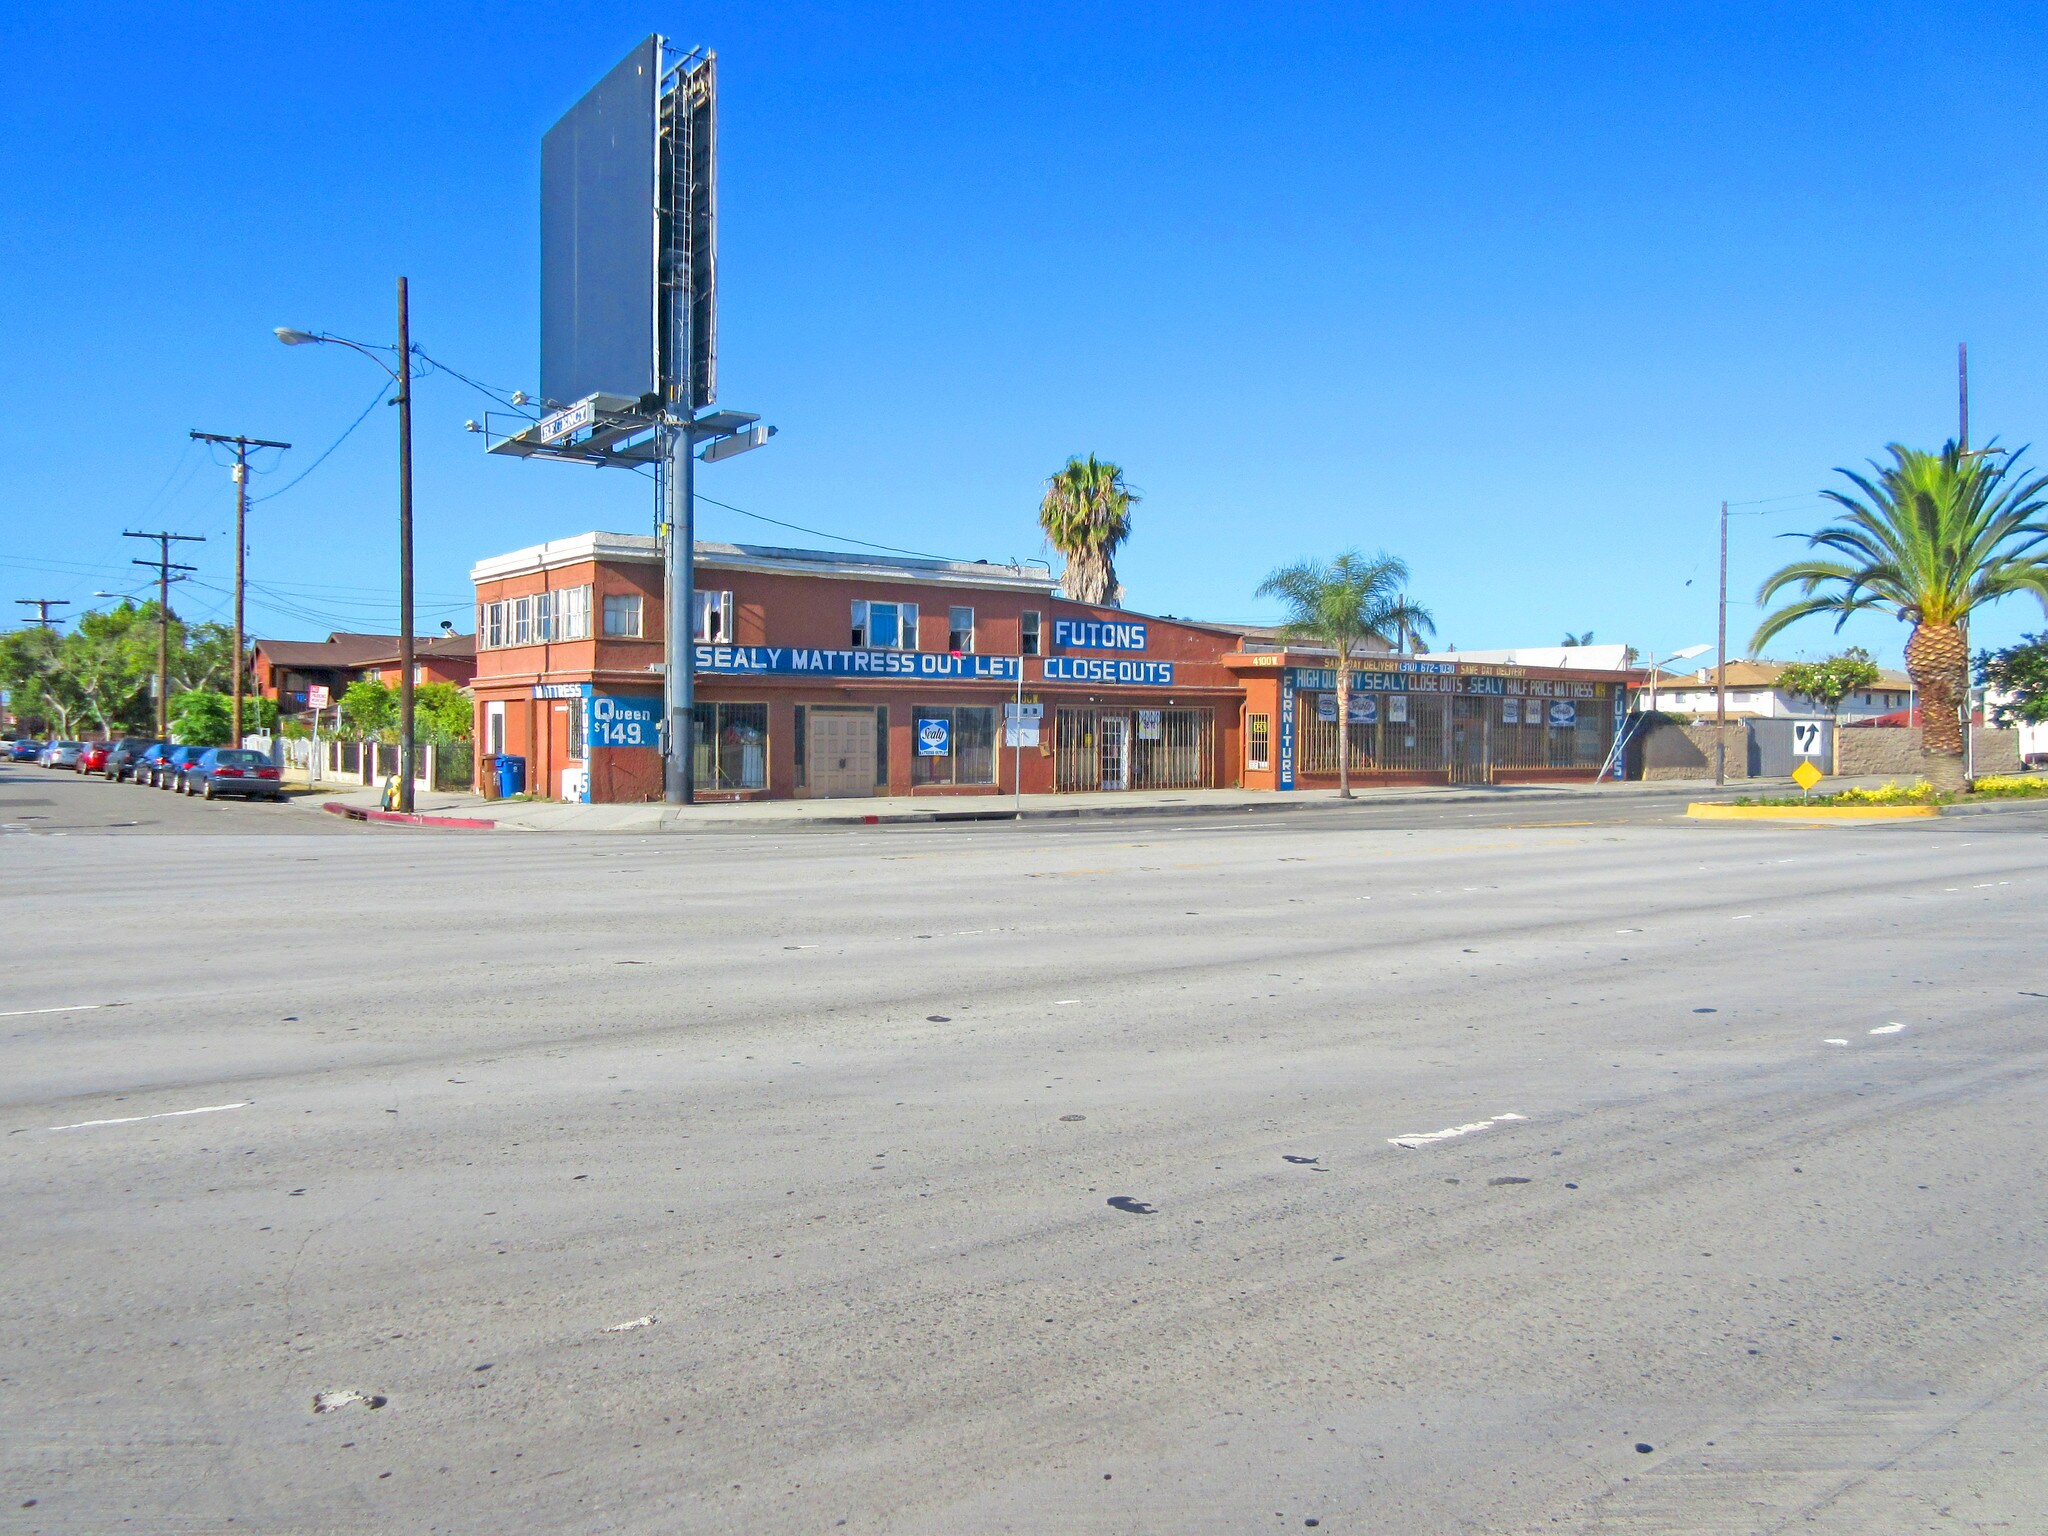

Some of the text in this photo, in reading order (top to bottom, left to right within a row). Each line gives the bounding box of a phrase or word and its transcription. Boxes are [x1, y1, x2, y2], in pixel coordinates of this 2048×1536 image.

[543, 407, 586, 439] REGENCY
[1056, 621, 1144, 649] FUTONS
[695, 646, 1018, 675] SEALY MATTRESS OUT LET
[1044, 658, 1171, 682] CLOSE OUTS
[1363, 660, 1399, 672] DELIVERY
[1399, 661, 1455, 674] (310) 672-1030
[1296, 669, 1319, 688] HIGH
[1321, 670, 1362, 690] QUTY
[1364, 673, 1407, 691] SEALY
[1408, 674, 1438, 691] CLOSE
[1440, 676, 1463, 693] OUTS
[1506, 678, 1527, 696] HALF
[1530, 680, 1552, 697] PRICE
[1554, 681, 1594, 698] MATTRESS
[594, 698, 651, 722] Queen
[922, 727, 945, 742] Sealy
[1282, 675, 1293, 783] FURNITURE
